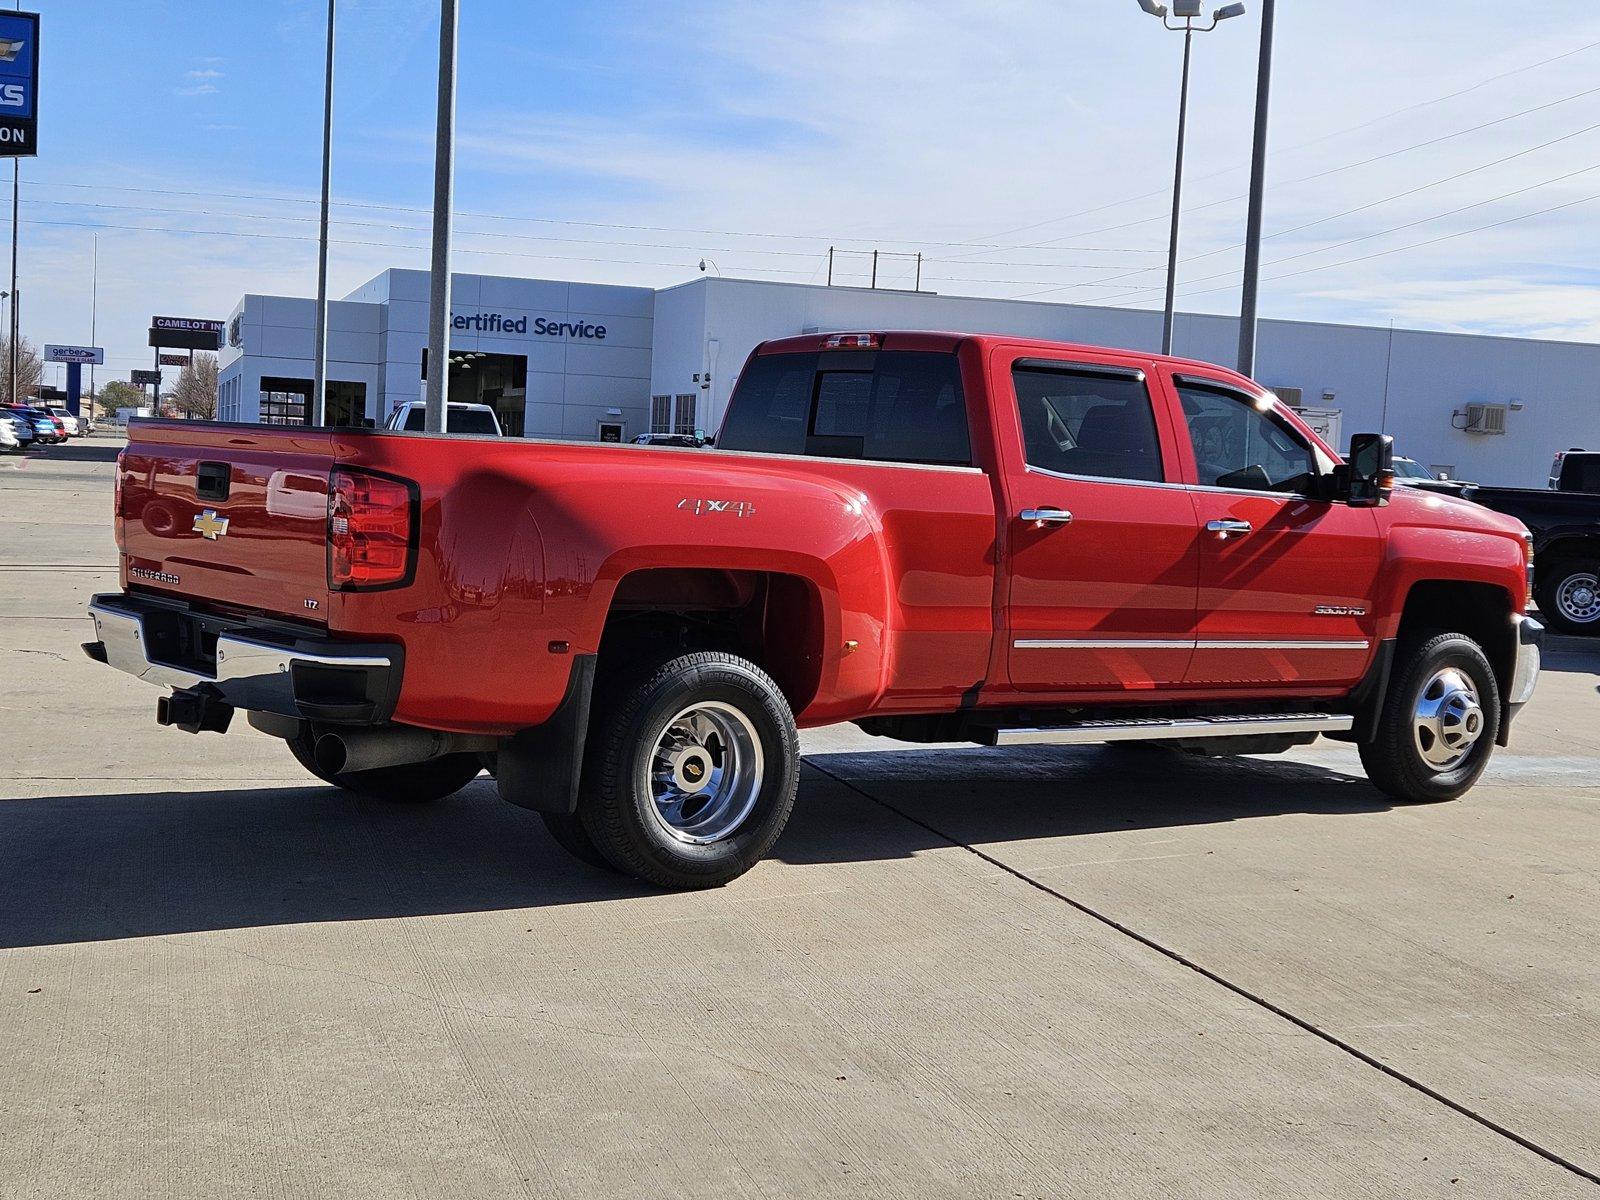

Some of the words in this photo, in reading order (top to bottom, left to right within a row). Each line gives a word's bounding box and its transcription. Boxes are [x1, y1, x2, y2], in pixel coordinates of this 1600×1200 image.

[0, 84, 24, 106] S
[157, 319, 206, 329] CAMELOT
[534, 317, 607, 339] Service
[53, 348, 86, 356] gerber
[132, 567, 180, 585] SILVERADO
[304, 599, 320, 611] LTZ
